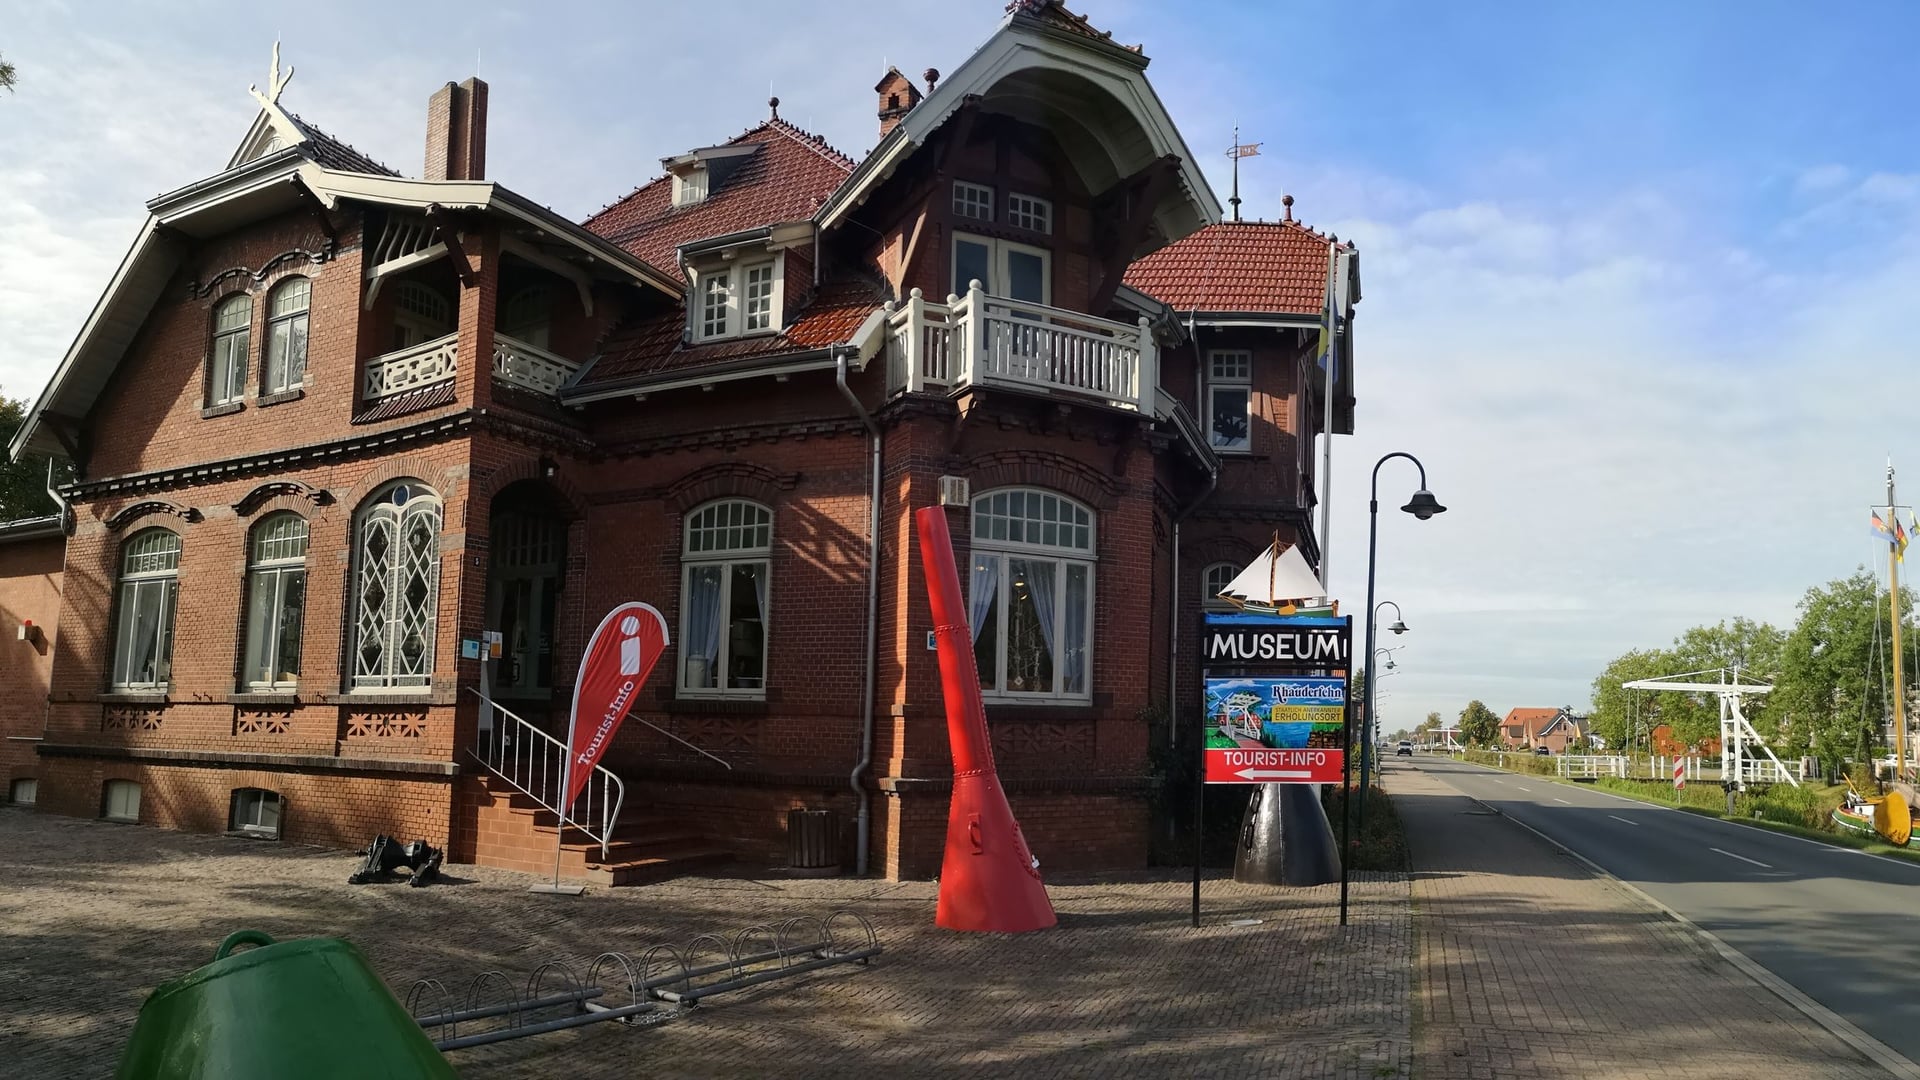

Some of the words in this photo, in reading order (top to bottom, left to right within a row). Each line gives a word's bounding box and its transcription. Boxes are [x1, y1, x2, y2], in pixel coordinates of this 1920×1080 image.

[1210, 633, 1340, 660] MUSEUM
[1272, 684, 1342, 704] Rhauderfehn
[577, 680, 635, 766] Tourist-Info
[1275, 712, 1342, 721] ERHOLUNGSORT
[1223, 751, 1327, 766] TOURIST-INFO
